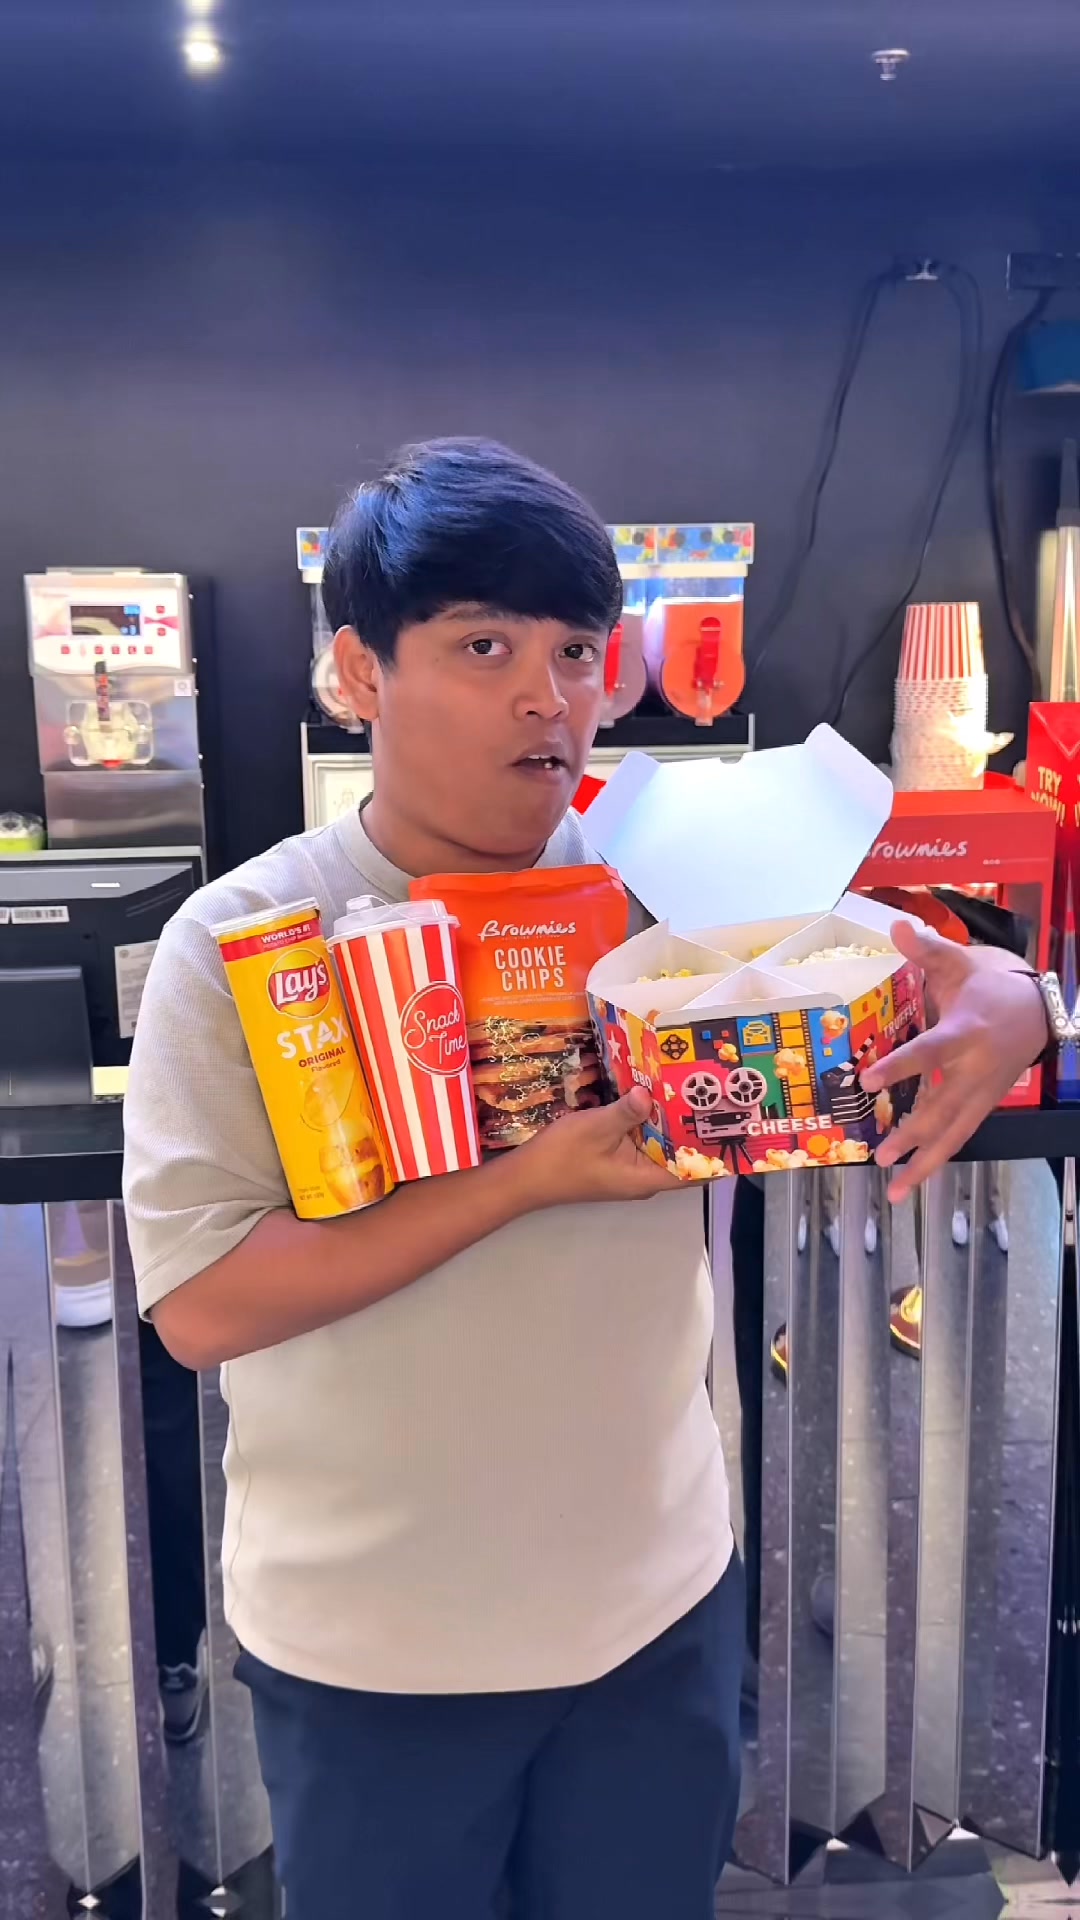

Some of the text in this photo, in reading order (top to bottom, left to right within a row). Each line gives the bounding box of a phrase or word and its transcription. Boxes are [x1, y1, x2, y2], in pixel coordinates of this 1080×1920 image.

[1037, 765, 1063, 797] TRY
[867, 838, 968, 859] rownies
[261, 926, 302, 944] WORLD'S
[477, 919, 577, 943] Brownies
[494, 945, 567, 970] COOKIE
[274, 962, 328, 1006] Lay's
[501, 967, 565, 992] CHIPS
[403, 998, 460, 1049] Snack
[883, 997, 918, 1040] TRUFFLE
[276, 1013, 349, 1059] STAX
[428, 1031, 467, 1065] Time
[298, 1046, 346, 1068] ORIGINAL
[747, 1113, 833, 1137] CHEESE
